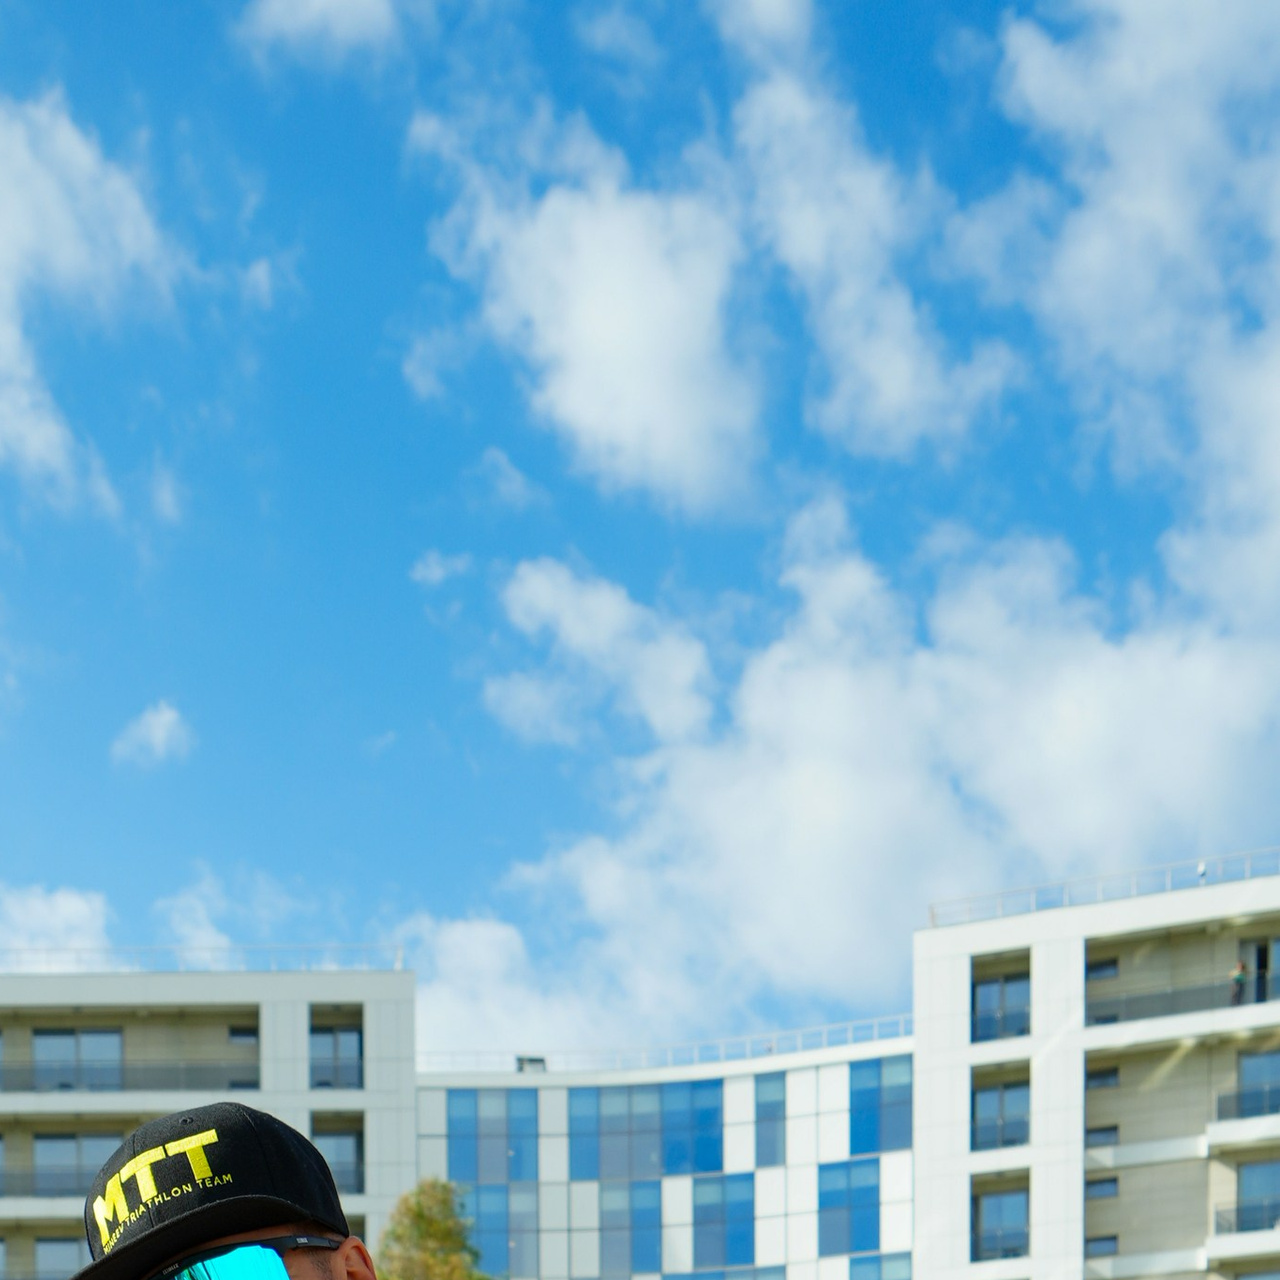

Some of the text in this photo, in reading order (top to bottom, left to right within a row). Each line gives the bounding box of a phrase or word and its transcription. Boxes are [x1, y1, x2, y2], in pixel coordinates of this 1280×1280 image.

[92, 1128, 219, 1246] MTT
[124, 1183, 193, 1227] TRIATHLON
[196, 1173, 233, 1189] TEAM
